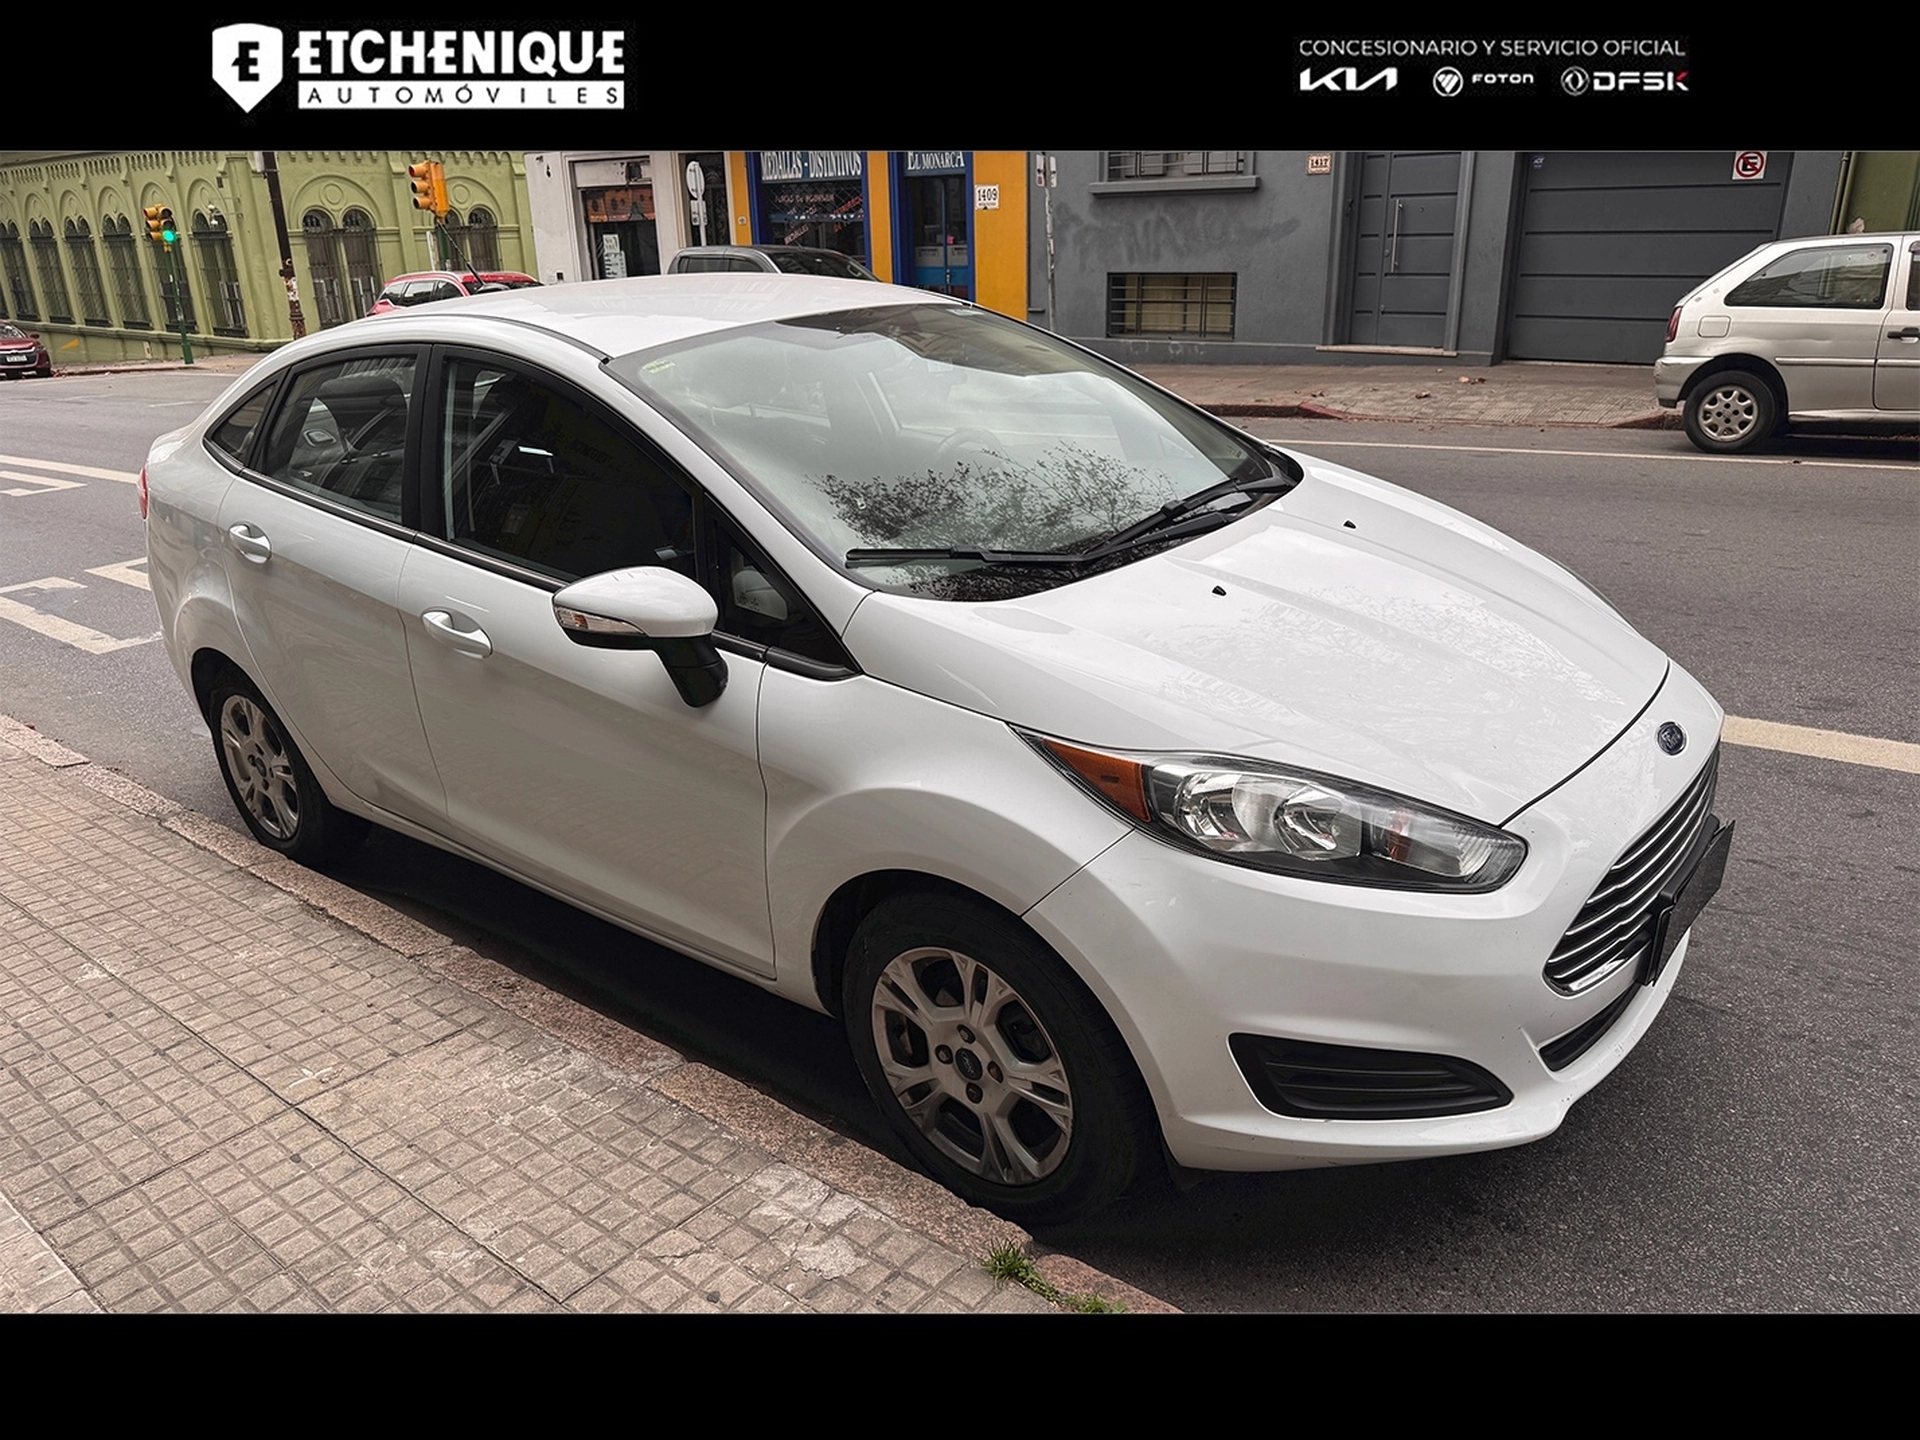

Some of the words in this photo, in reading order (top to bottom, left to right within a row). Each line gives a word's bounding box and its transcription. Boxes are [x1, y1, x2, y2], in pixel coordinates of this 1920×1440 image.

[760, 152, 803, 181] MEDALLAS
[809, 152, 862, 179] DISTINTIVOS
[1311, 158, 1329, 168] 1417
[977, 188, 998, 201] 1409
